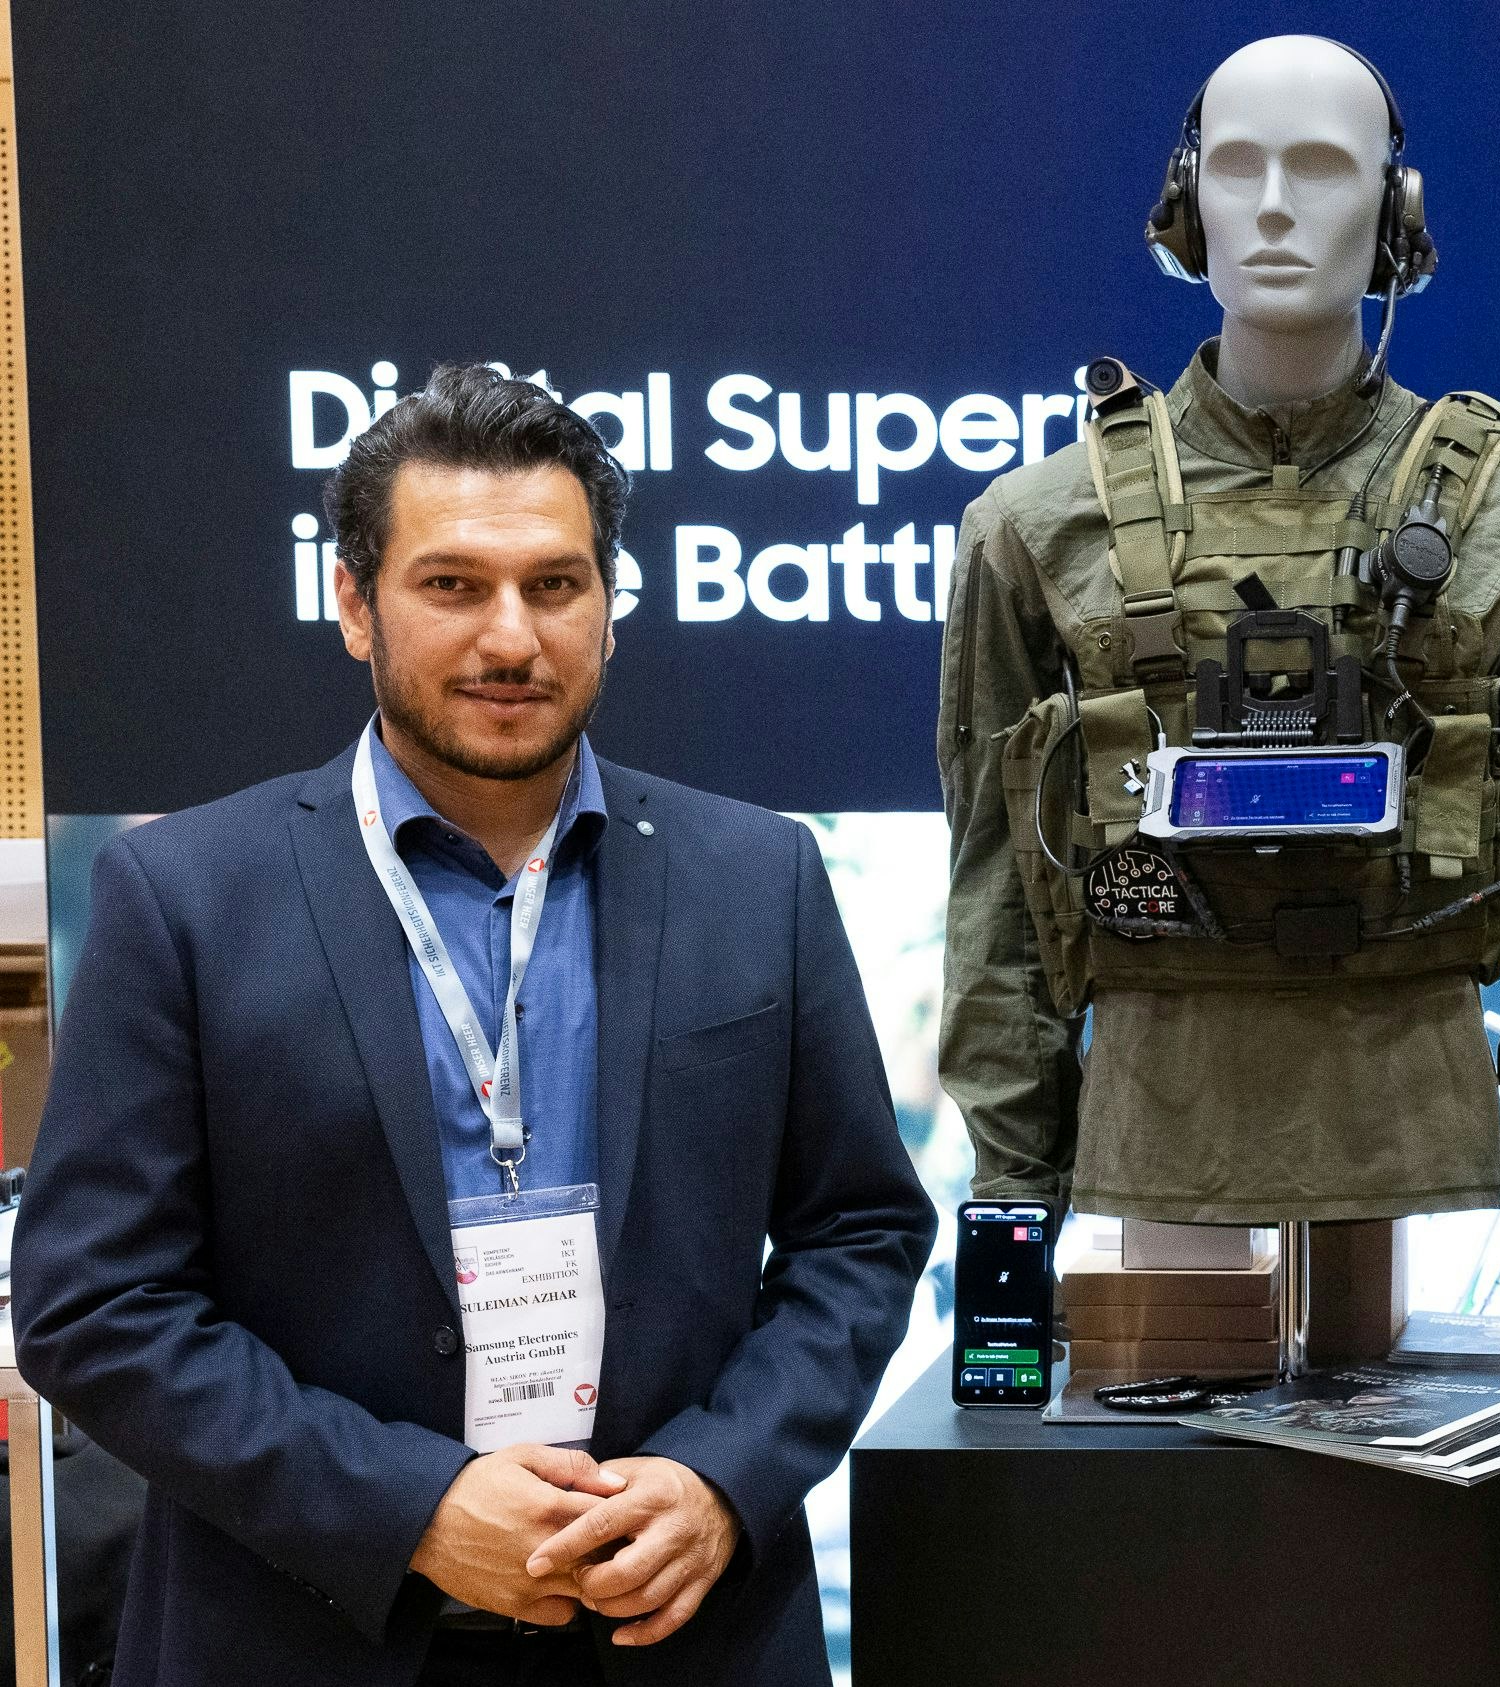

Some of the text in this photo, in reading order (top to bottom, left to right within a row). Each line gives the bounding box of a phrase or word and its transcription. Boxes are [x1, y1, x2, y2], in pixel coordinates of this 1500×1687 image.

[519, 876, 539, 929] UNSER HEER
[1111, 885, 1178, 900] TACTICAL
[1138, 900, 1176, 914] CORE
[387, 865, 447, 978] IKT SICHERHEITSKONFERENZ
[461, 1021, 490, 1078] UNSER HEER
[561, 1239, 575, 1247] WE
[561, 1249, 576, 1258] IKT
[521, 1269, 580, 1284] EXHIBITION
[460, 1289, 577, 1314] SULEIMAN AZHAR
[465, 1330, 579, 1354] Samsung Electronics
[485, 1345, 566, 1366] Austria GmbH
